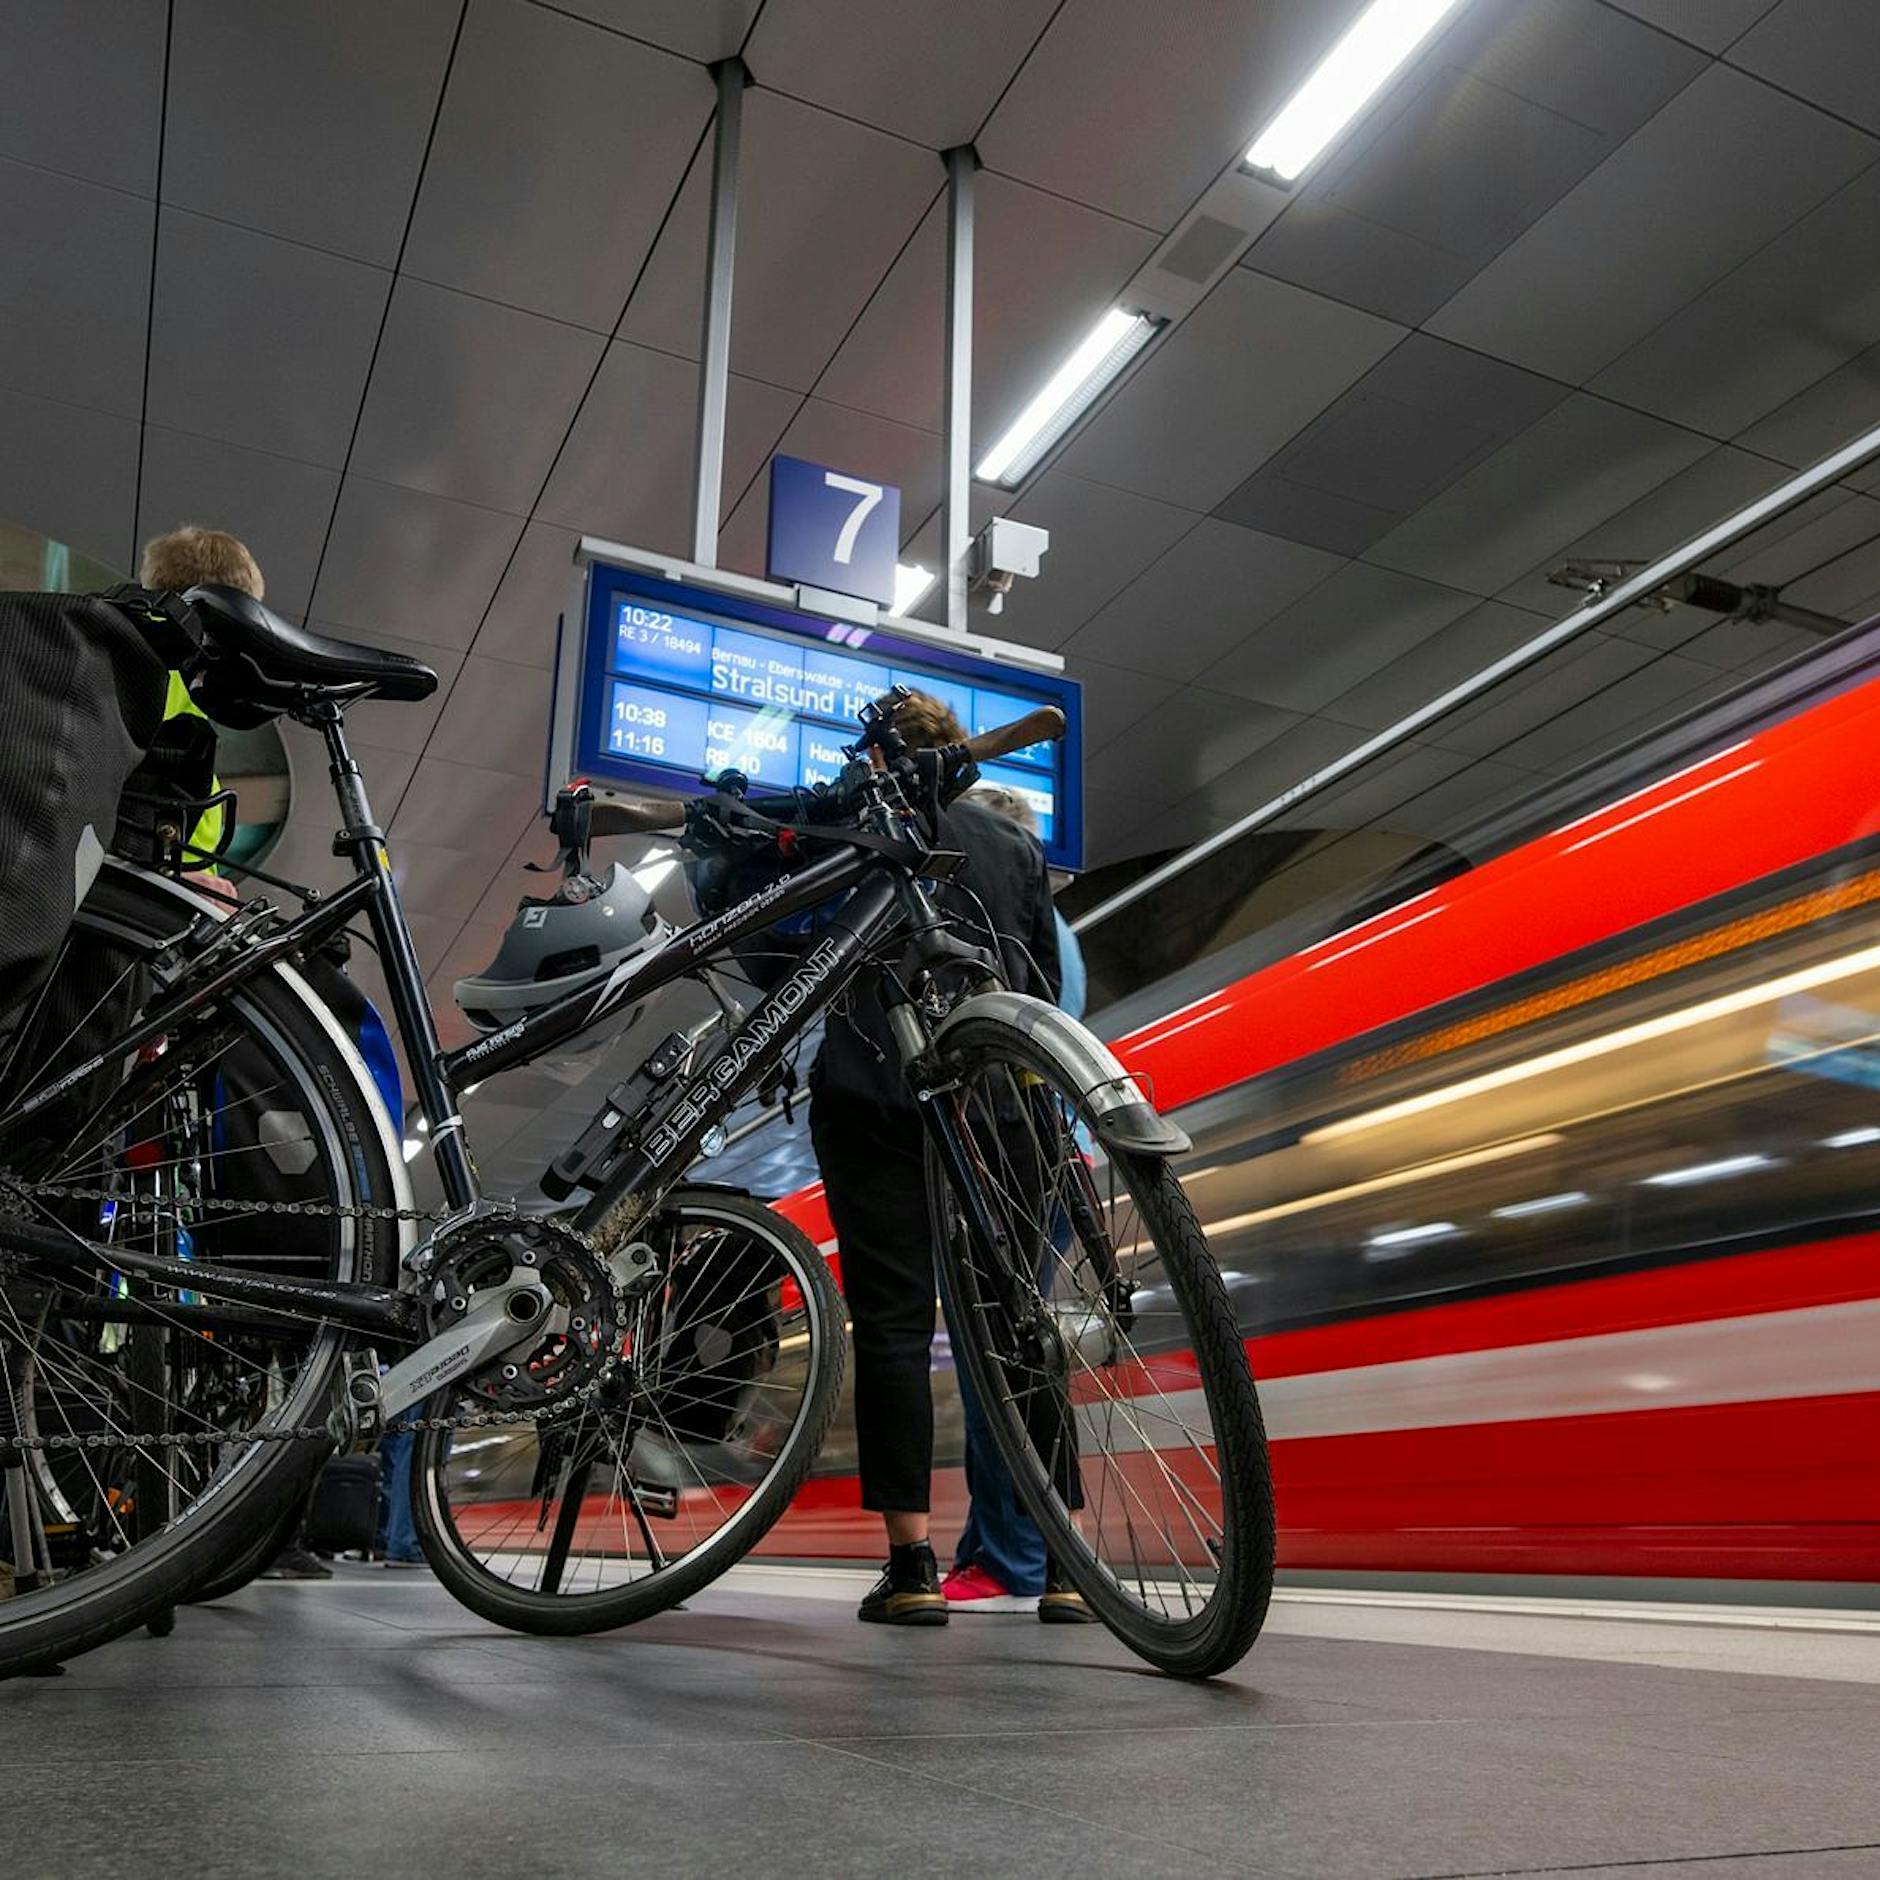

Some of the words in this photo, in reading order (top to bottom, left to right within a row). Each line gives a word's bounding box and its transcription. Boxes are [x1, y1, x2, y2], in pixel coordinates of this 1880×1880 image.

[825, 471, 883, 565] 7
[619, 624, 635, 640] RE
[640, 628, 648, 643] 3
[664, 636, 702, 655] 18494
[621, 606, 672, 632] 10:22
[712, 648, 756, 669] Bernau
[768, 660, 843, 689] Eberswalde
[712, 664, 834, 713] Stralsund
[613, 729, 665, 755] 11:16
[614, 702, 667, 728] 10:38
[707, 720, 735, 742] ICE
[810, 742, 850, 766] Ham
[640, 938, 840, 1167] BERGAMONT
[317, 1064, 359, 1145] SCHWALBE
